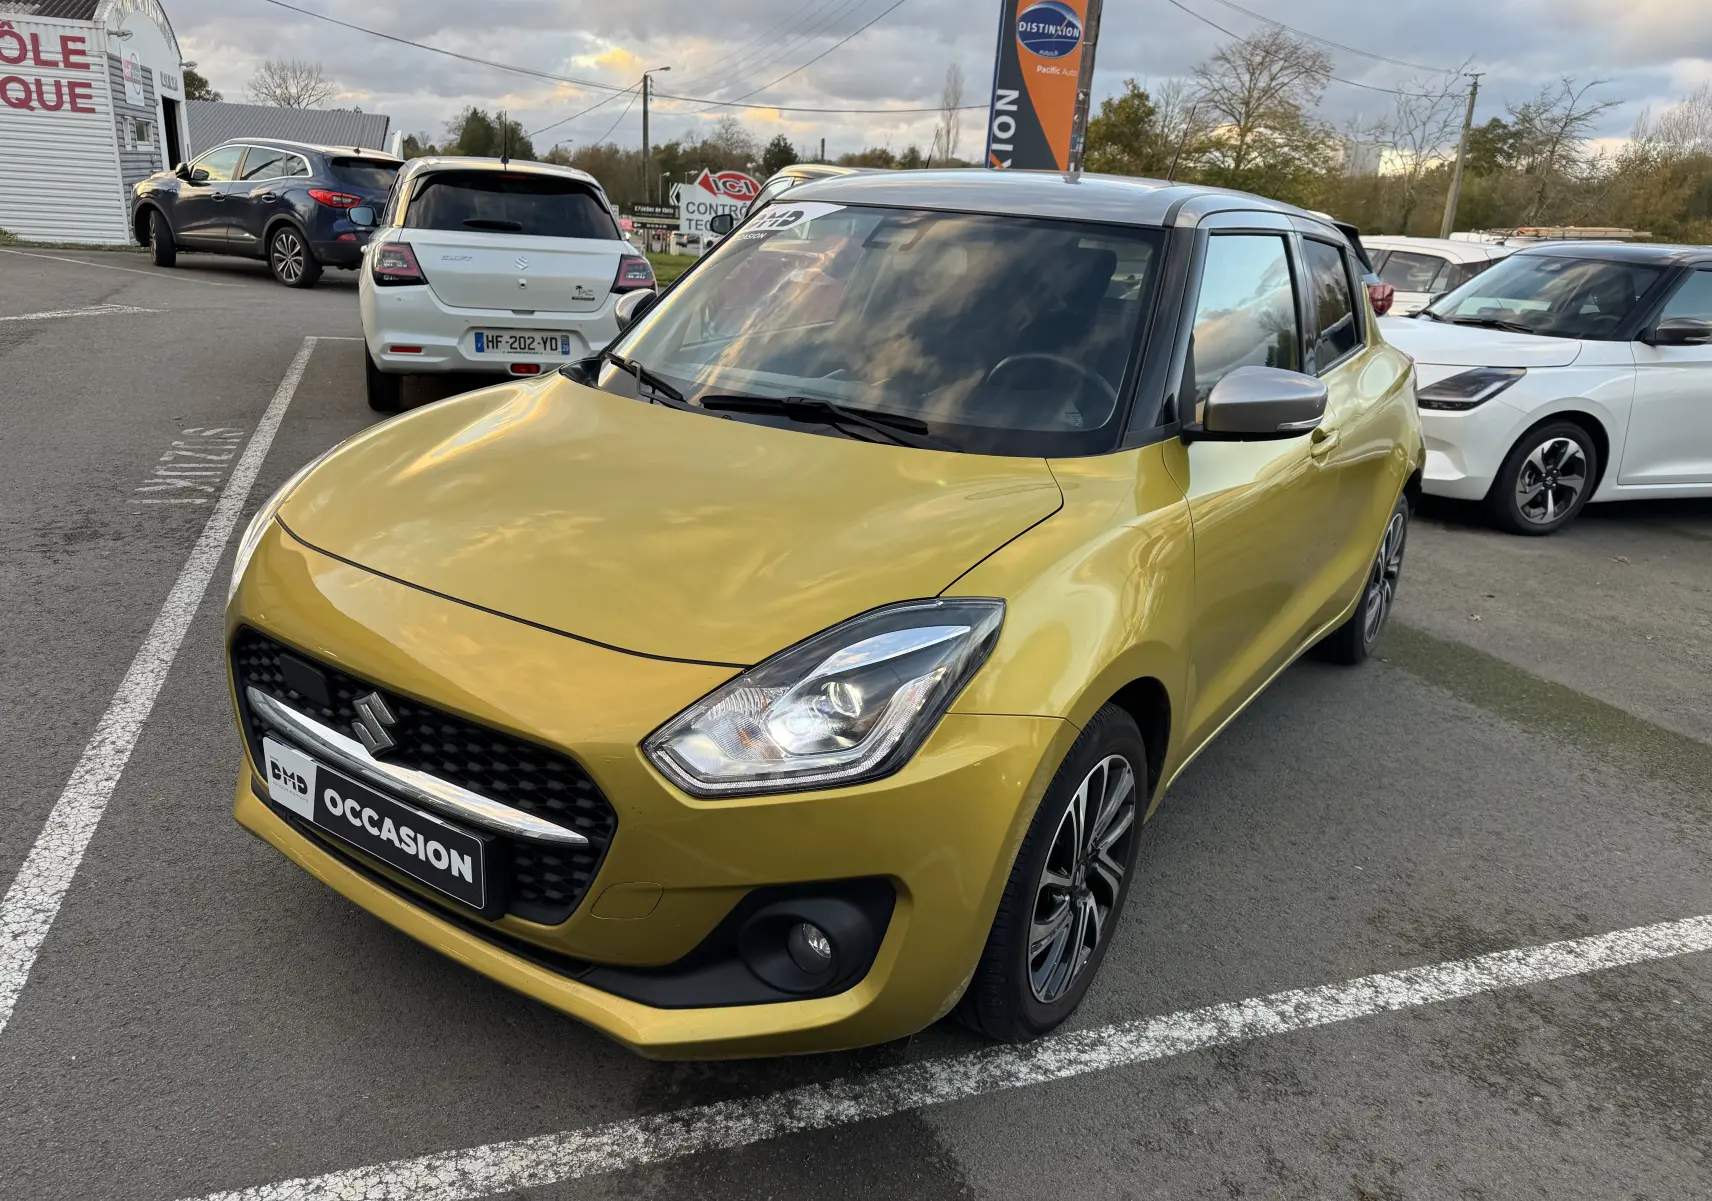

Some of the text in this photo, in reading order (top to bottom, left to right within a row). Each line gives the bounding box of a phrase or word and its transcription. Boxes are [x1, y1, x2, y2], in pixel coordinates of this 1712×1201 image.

[1018, 19, 1080, 38] DISTINXION
[0, 20, 91, 70] ÔLE
[1036, 65, 1078, 77] Pacific Auto
[0, 75, 96, 114] QUE
[710, 177, 757, 195] ICI
[323, 788, 473, 884] OCCASION
